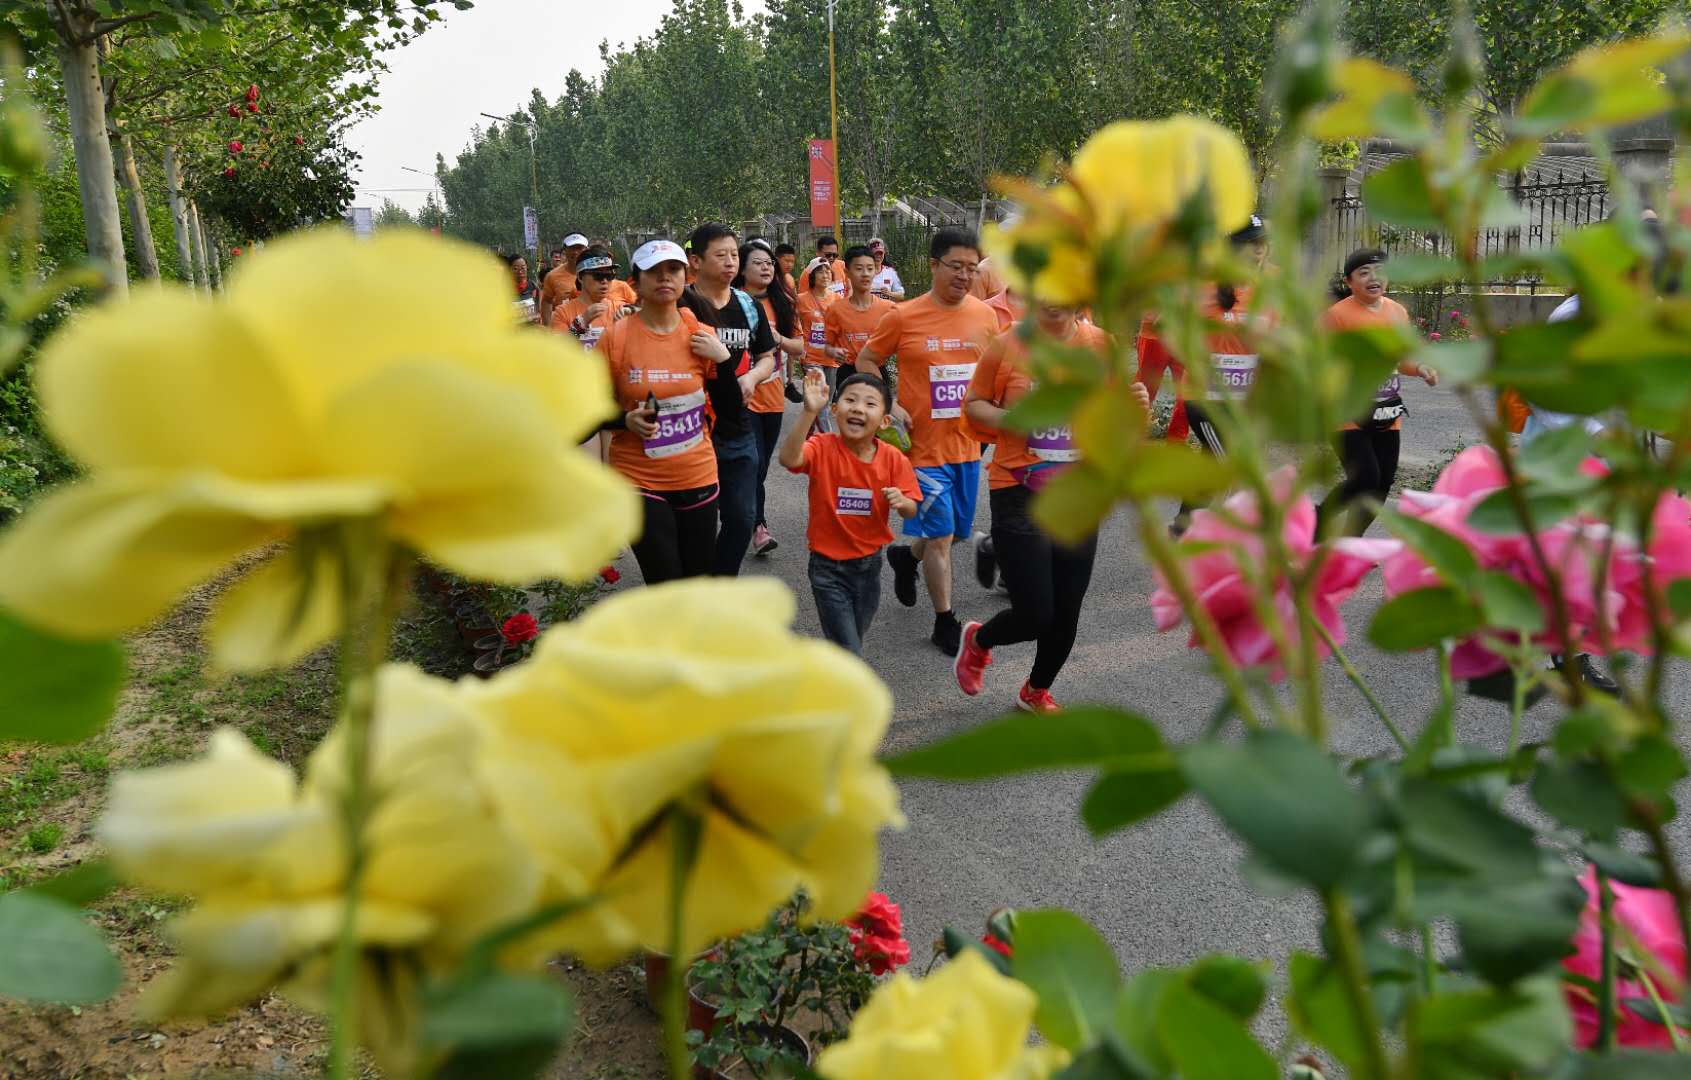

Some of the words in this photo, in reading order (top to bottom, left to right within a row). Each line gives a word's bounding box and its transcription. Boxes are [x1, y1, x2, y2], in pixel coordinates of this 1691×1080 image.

[935, 384, 968, 402] C50
[1033, 424, 1073, 440] C54
[839, 498, 870, 509] C5406
